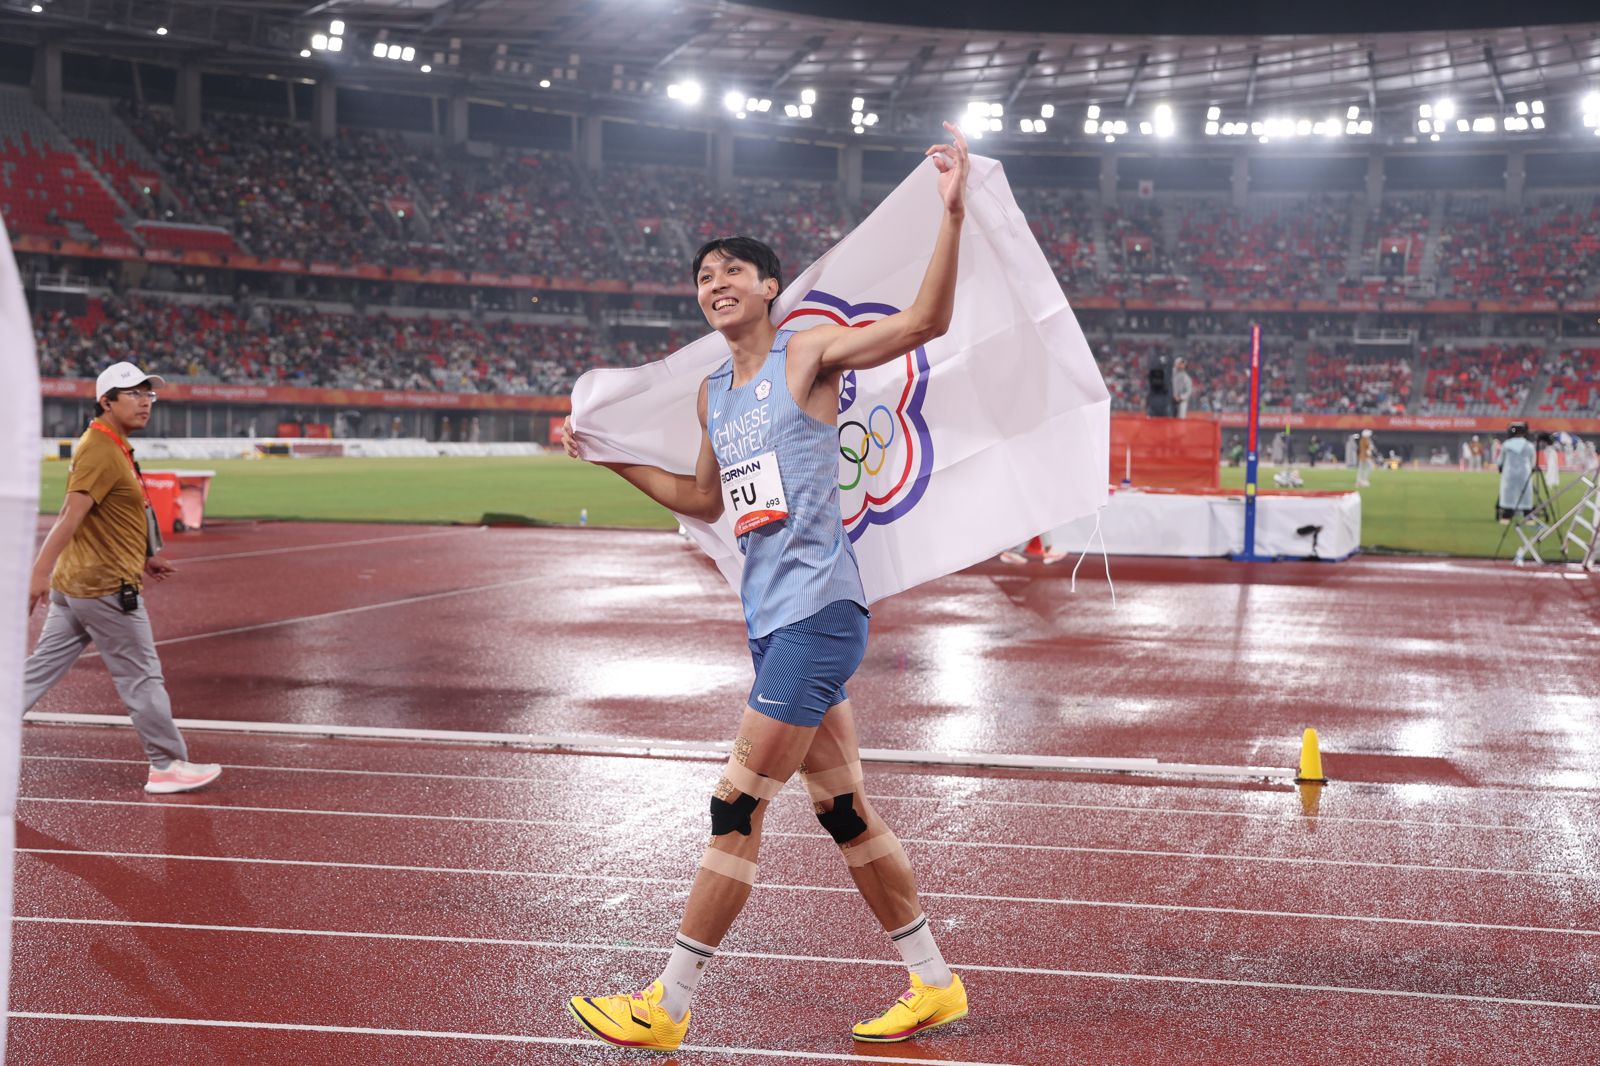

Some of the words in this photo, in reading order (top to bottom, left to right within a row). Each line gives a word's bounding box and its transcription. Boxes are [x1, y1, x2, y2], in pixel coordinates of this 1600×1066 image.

[714, 403, 770, 448] CHINESE
[730, 482, 757, 511] FU
[765, 497, 780, 509] 693
